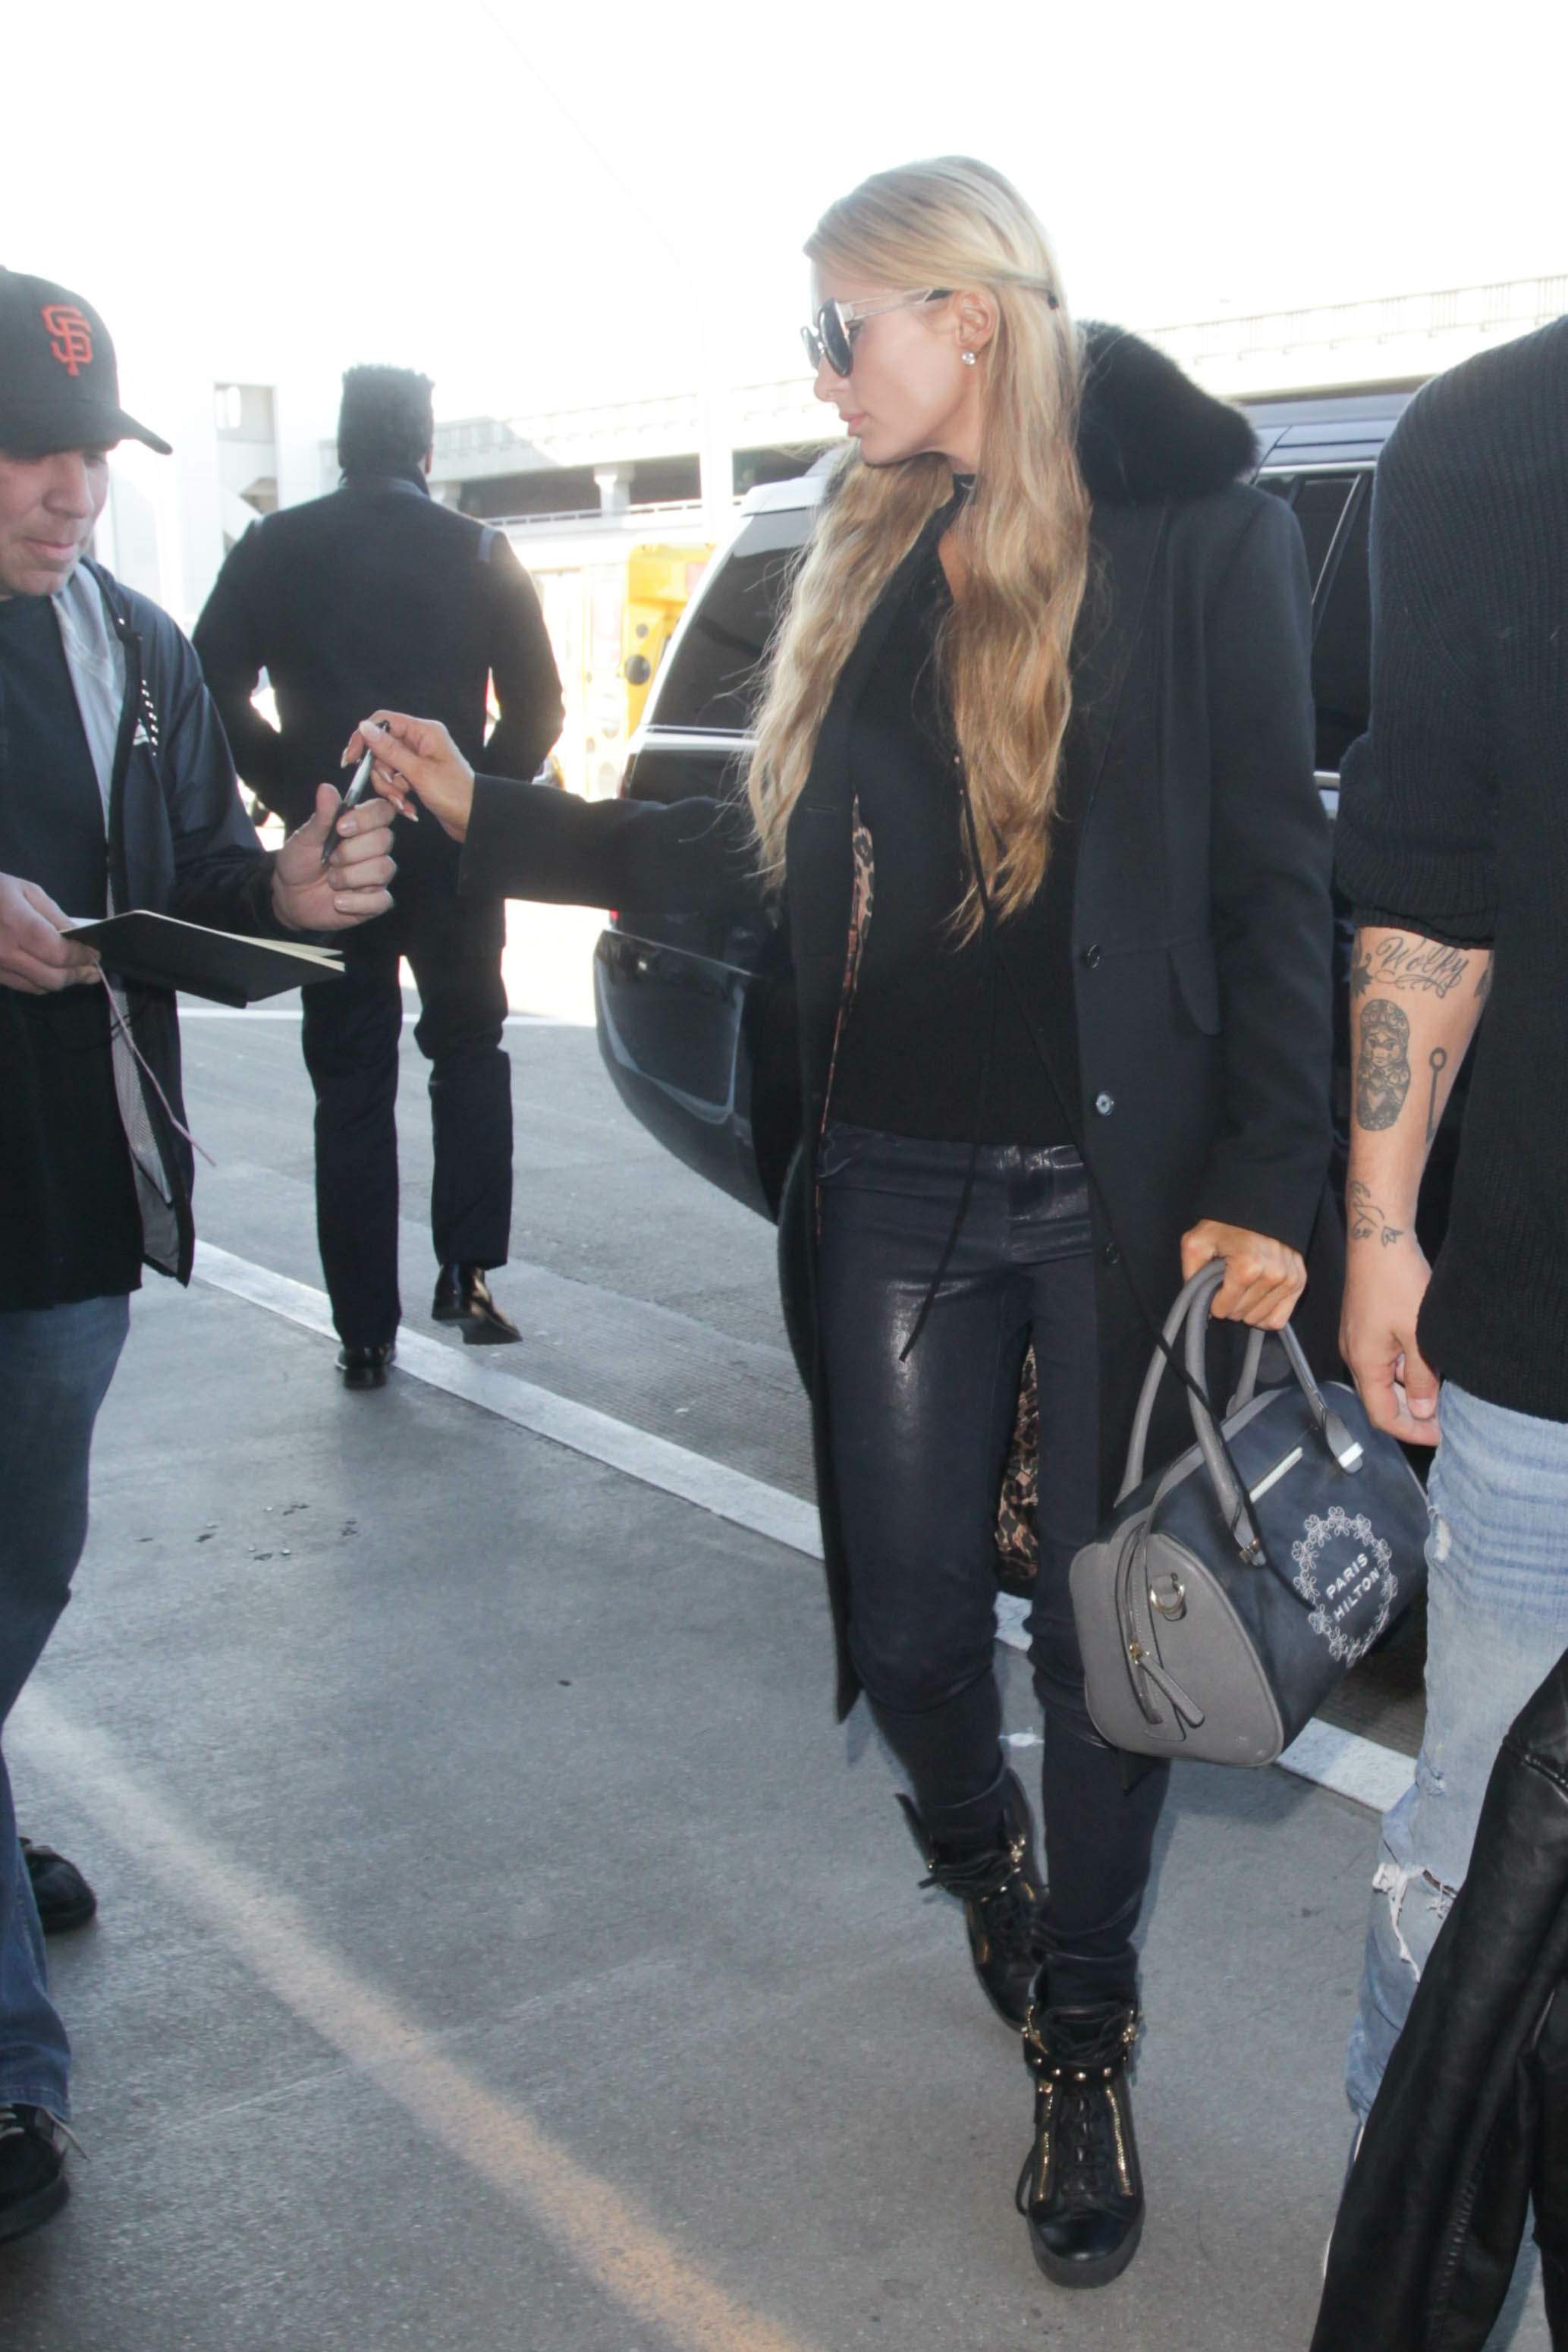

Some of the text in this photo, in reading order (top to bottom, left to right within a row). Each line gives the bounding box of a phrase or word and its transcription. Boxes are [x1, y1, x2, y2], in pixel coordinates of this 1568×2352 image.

[41, 303, 93, 377] SF
[1326, 1553, 1368, 1599] PARIS
[1333, 1567, 1380, 1621] HILTON
